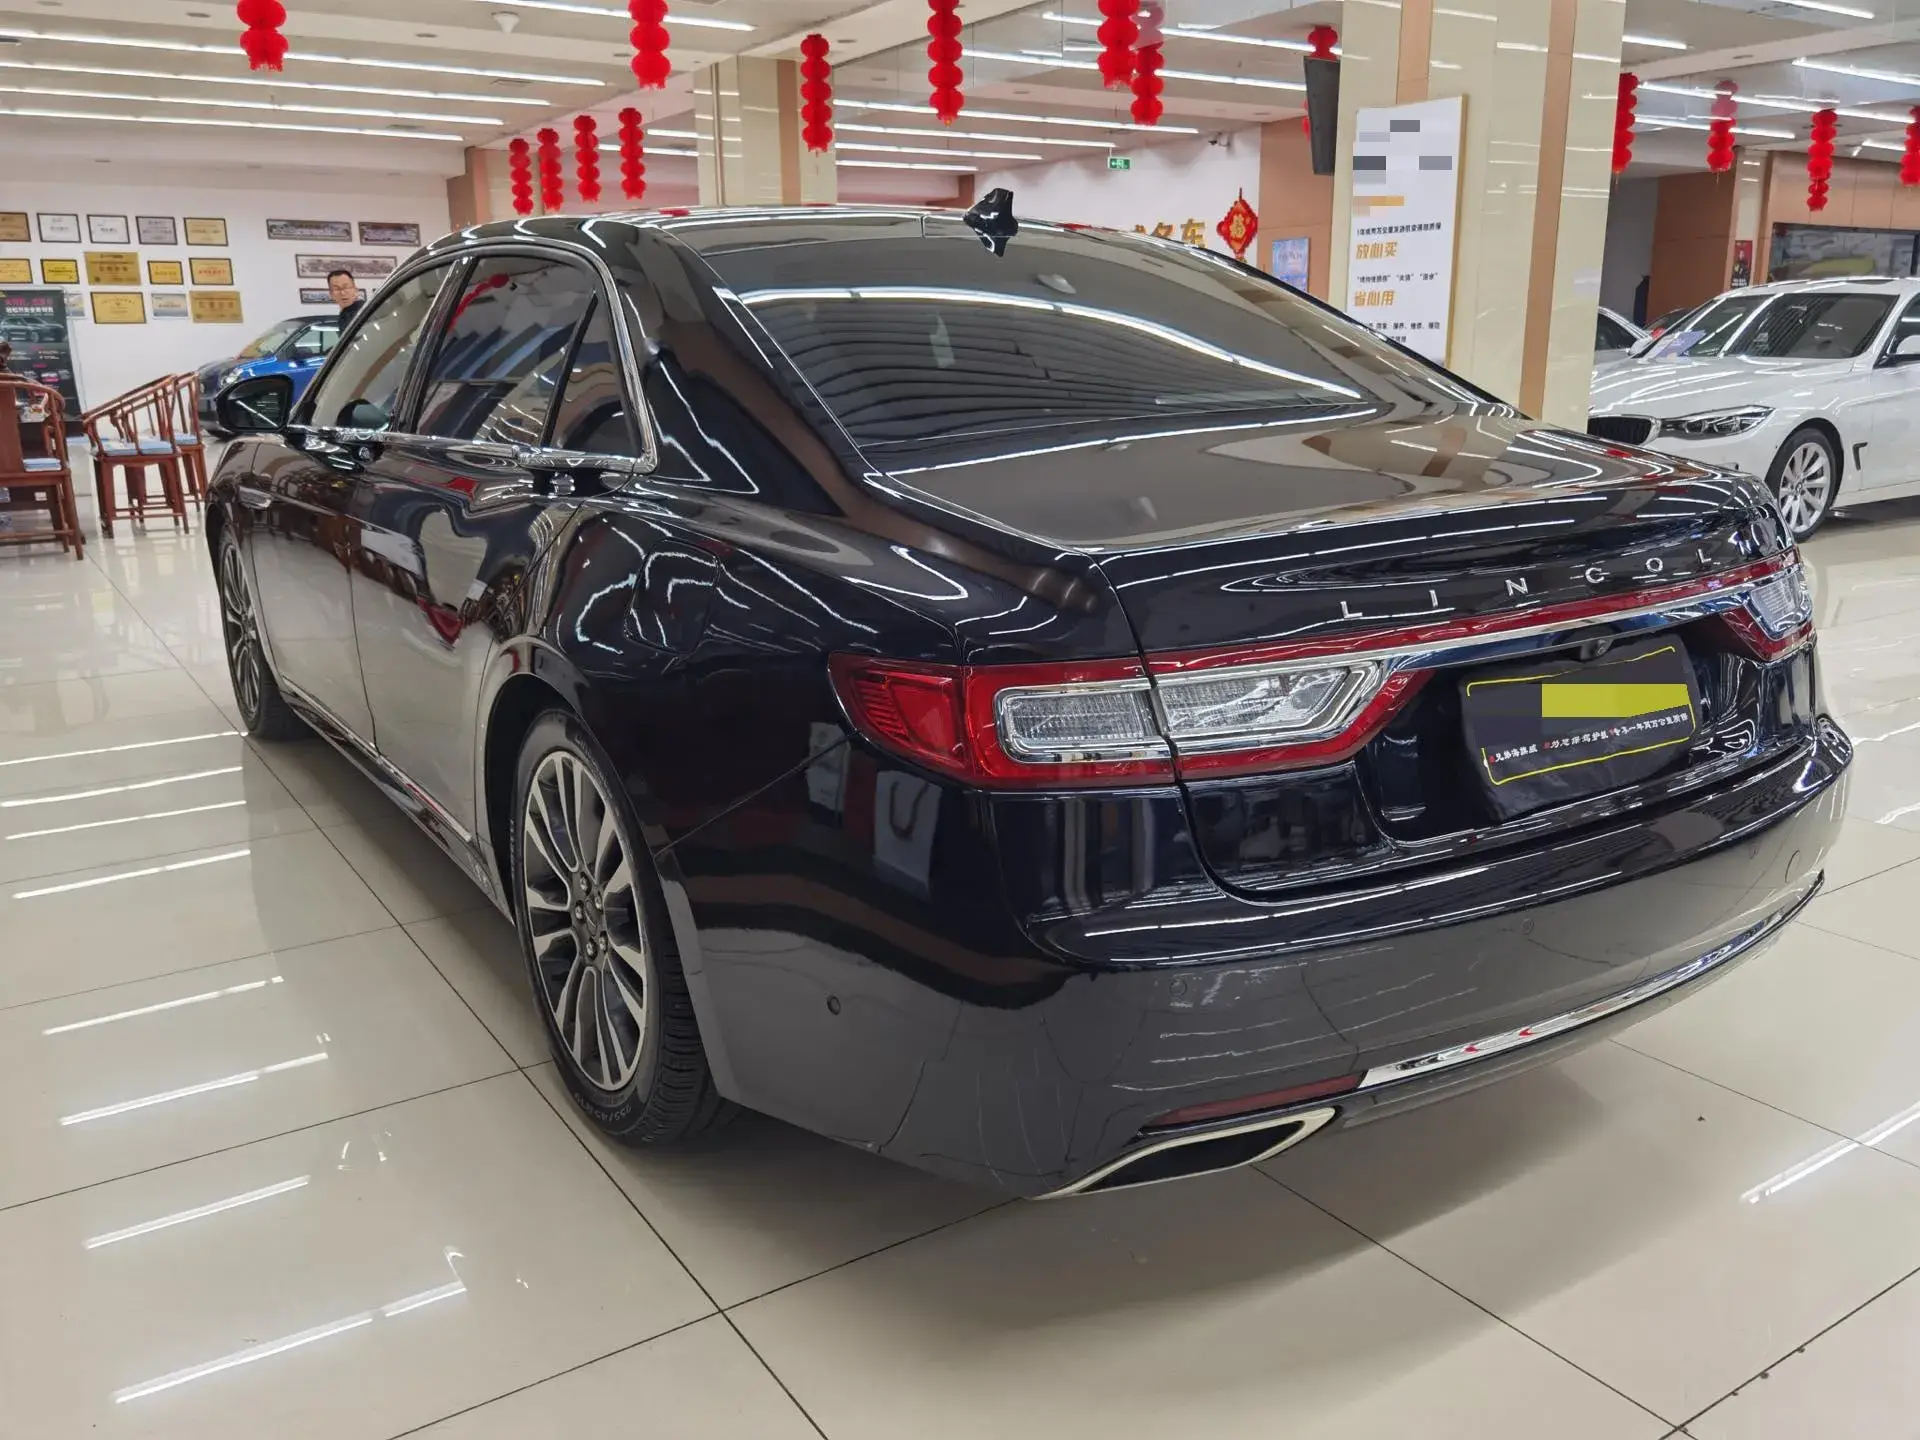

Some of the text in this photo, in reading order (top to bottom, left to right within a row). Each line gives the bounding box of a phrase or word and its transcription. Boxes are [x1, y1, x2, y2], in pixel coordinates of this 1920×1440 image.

[1355, 241, 1398, 260] 放心买
[1354, 289, 1396, 308] 省心用
